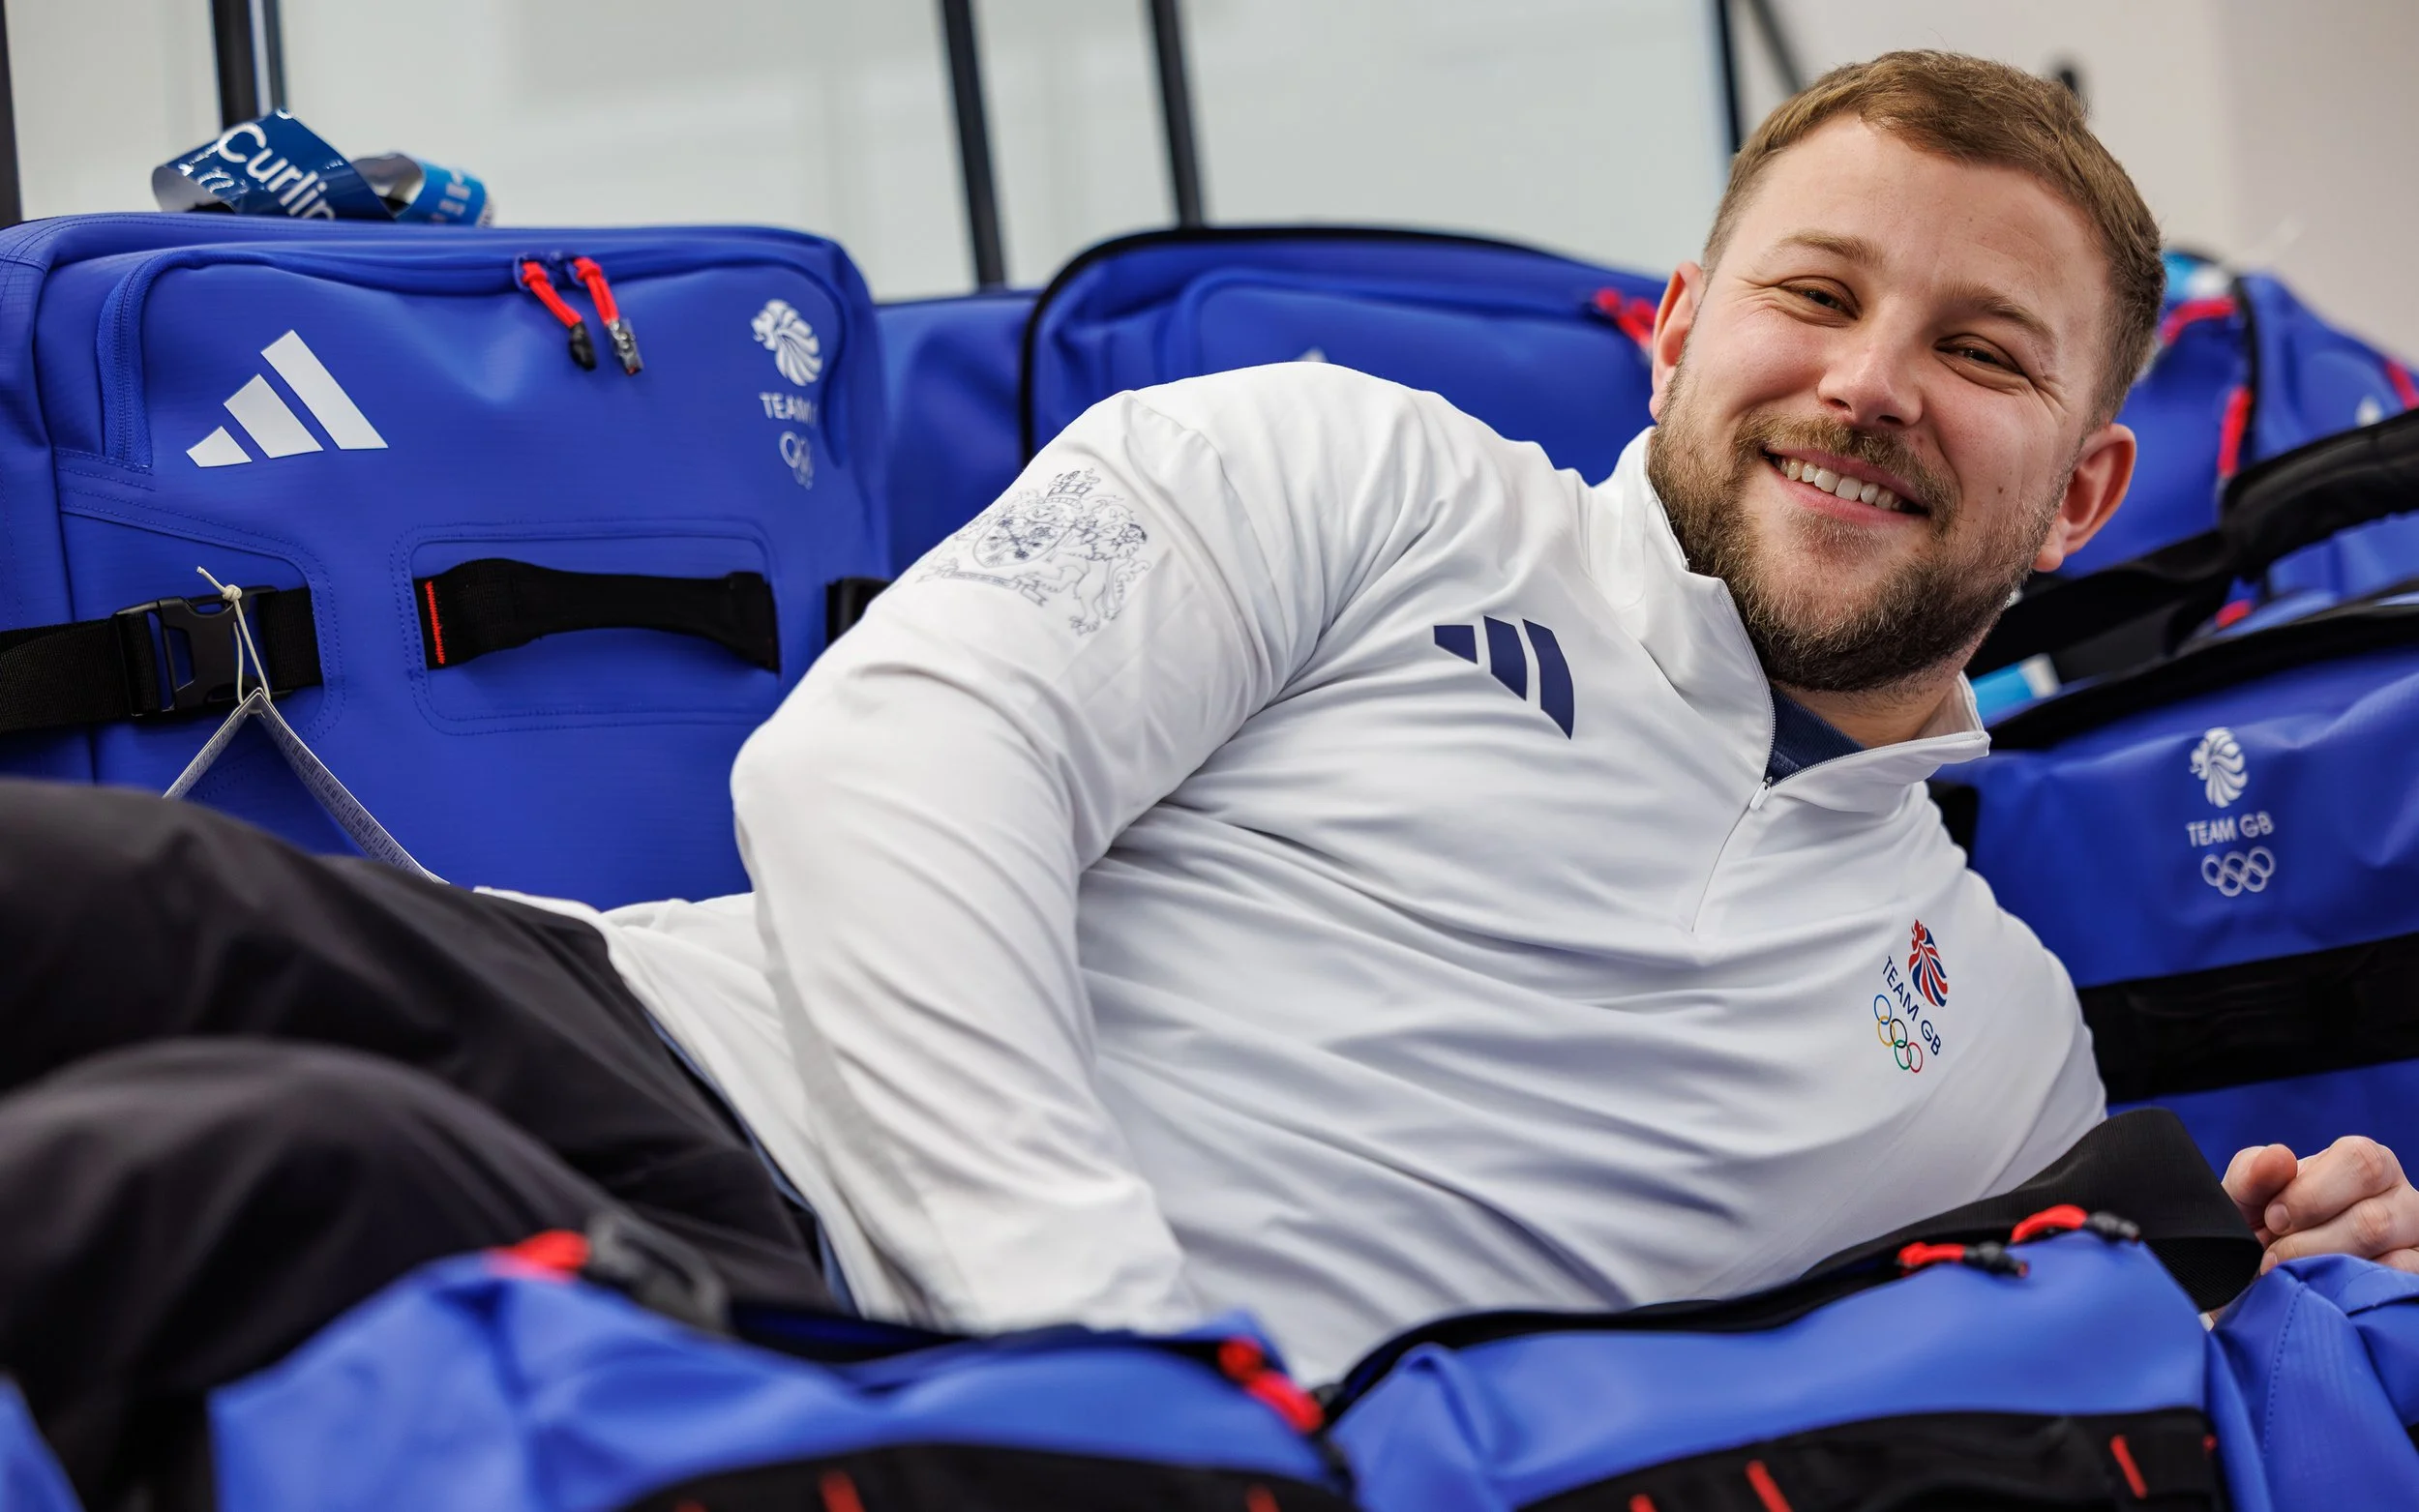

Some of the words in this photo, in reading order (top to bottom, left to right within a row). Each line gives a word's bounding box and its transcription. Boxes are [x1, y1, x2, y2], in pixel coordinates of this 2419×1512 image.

[2186, 816, 2238, 847] TEAM
[2239, 811, 2274, 838] GB
[1883, 955, 1920, 1022] TEAM
[1921, 1020, 1941, 1055] GB
